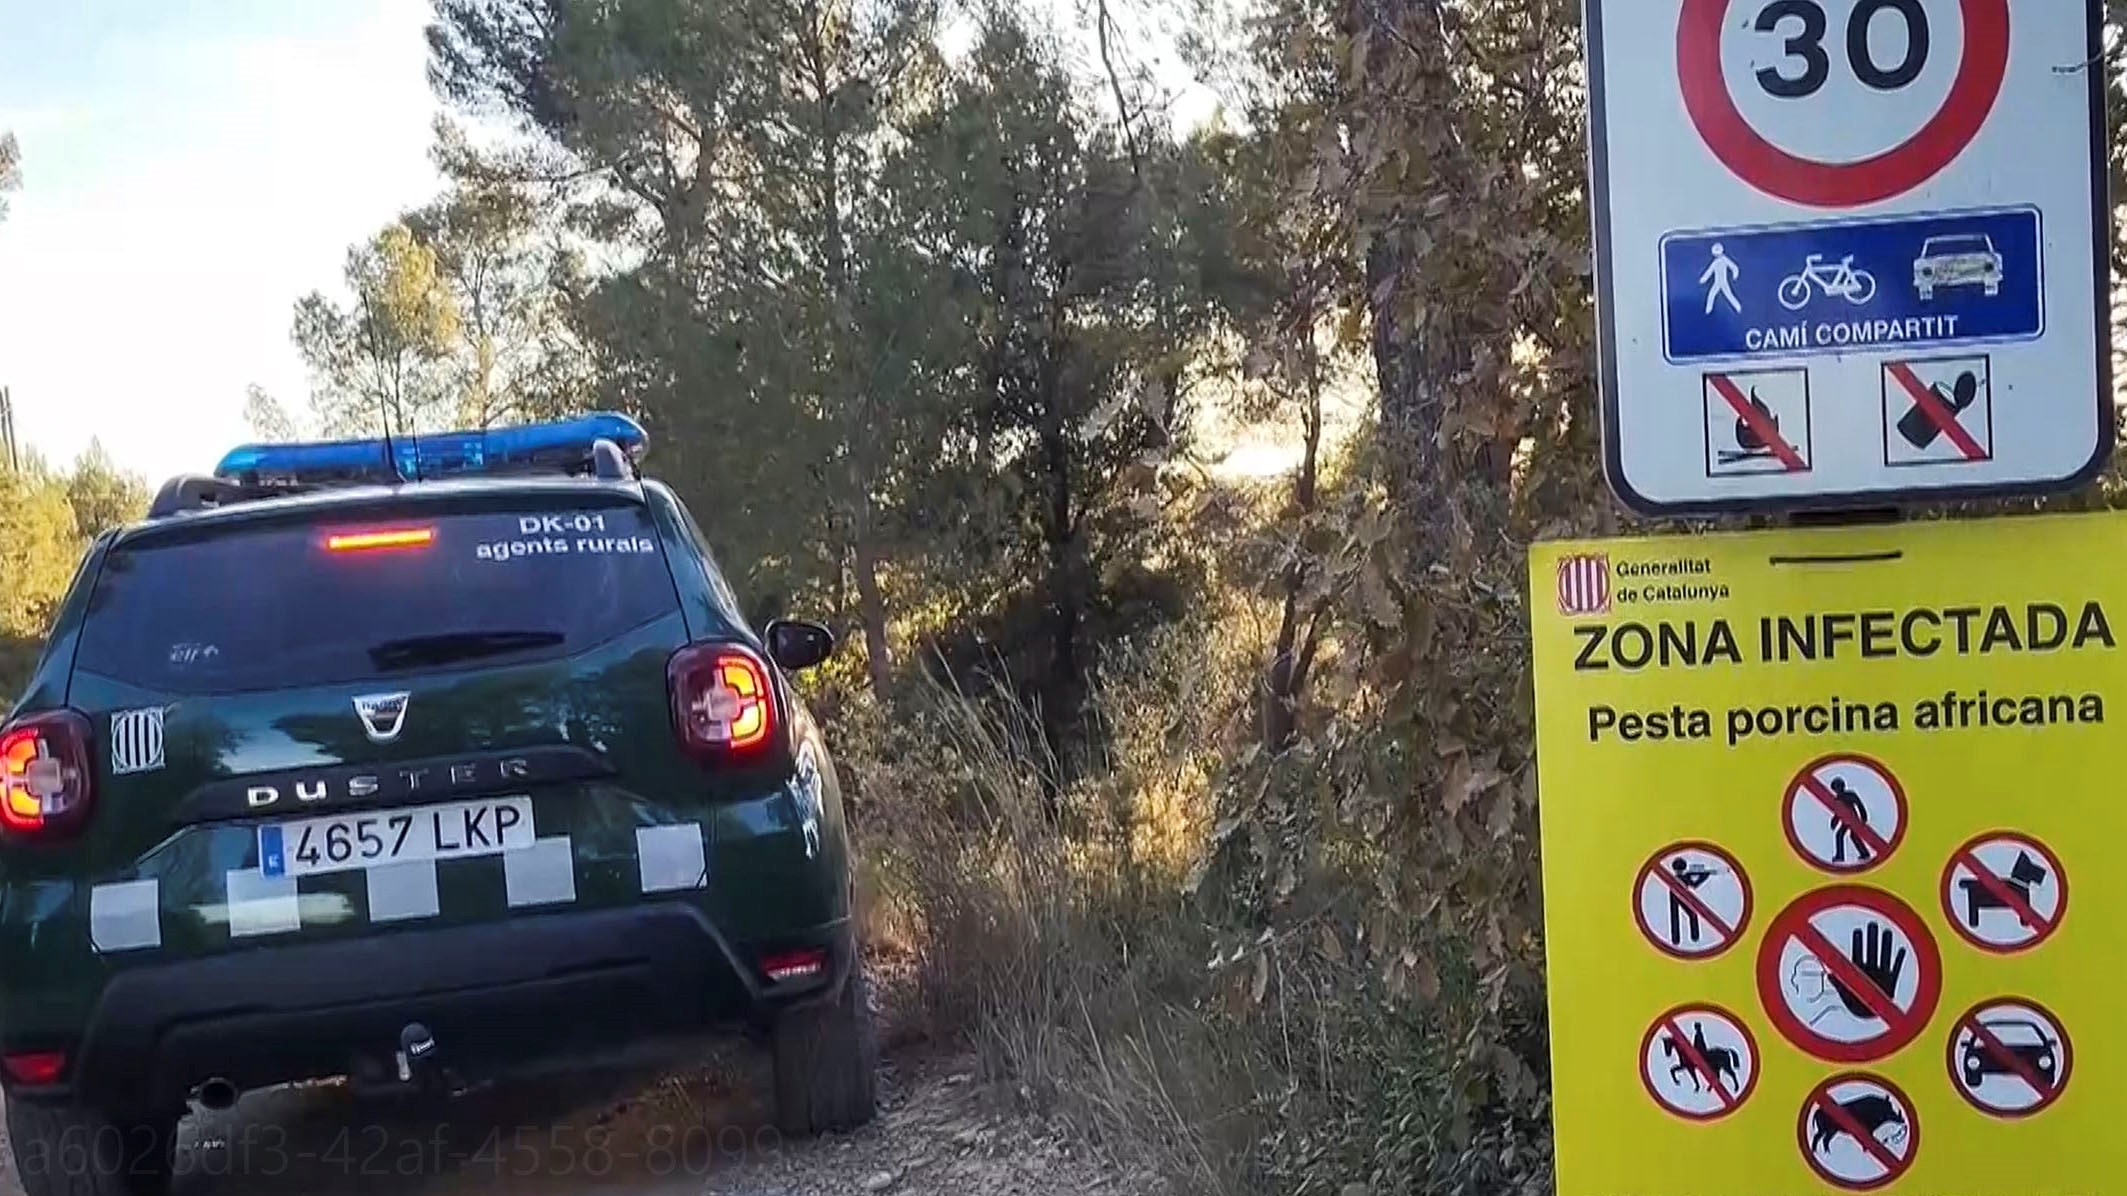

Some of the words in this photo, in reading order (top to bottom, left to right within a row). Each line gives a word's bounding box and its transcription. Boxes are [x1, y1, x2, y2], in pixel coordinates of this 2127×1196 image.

[1754, 0, 1930, 99] 30
[1746, 320, 1807, 350] CAMÍ
[1816, 315, 1959, 345] COMPARTIT
[519, 514, 605, 535] DK-01
[476, 538, 568, 561] agents
[577, 536, 654, 553] rurals
[1616, 557, 1711, 577] Generalitat
[1616, 587, 1638, 603] de
[1643, 584, 1730, 602] Catalunya
[1573, 619, 1742, 671] ZONA
[1760, 601, 2116, 662] INFECTADA
[1588, 703, 1712, 742] Pesta
[1728, 696, 1899, 746] porcina
[1915, 690, 2104, 731] africana
[247, 758, 528, 806] DUSTER
[296, 815, 413, 867] 4657
[433, 805, 521, 849] LKP
